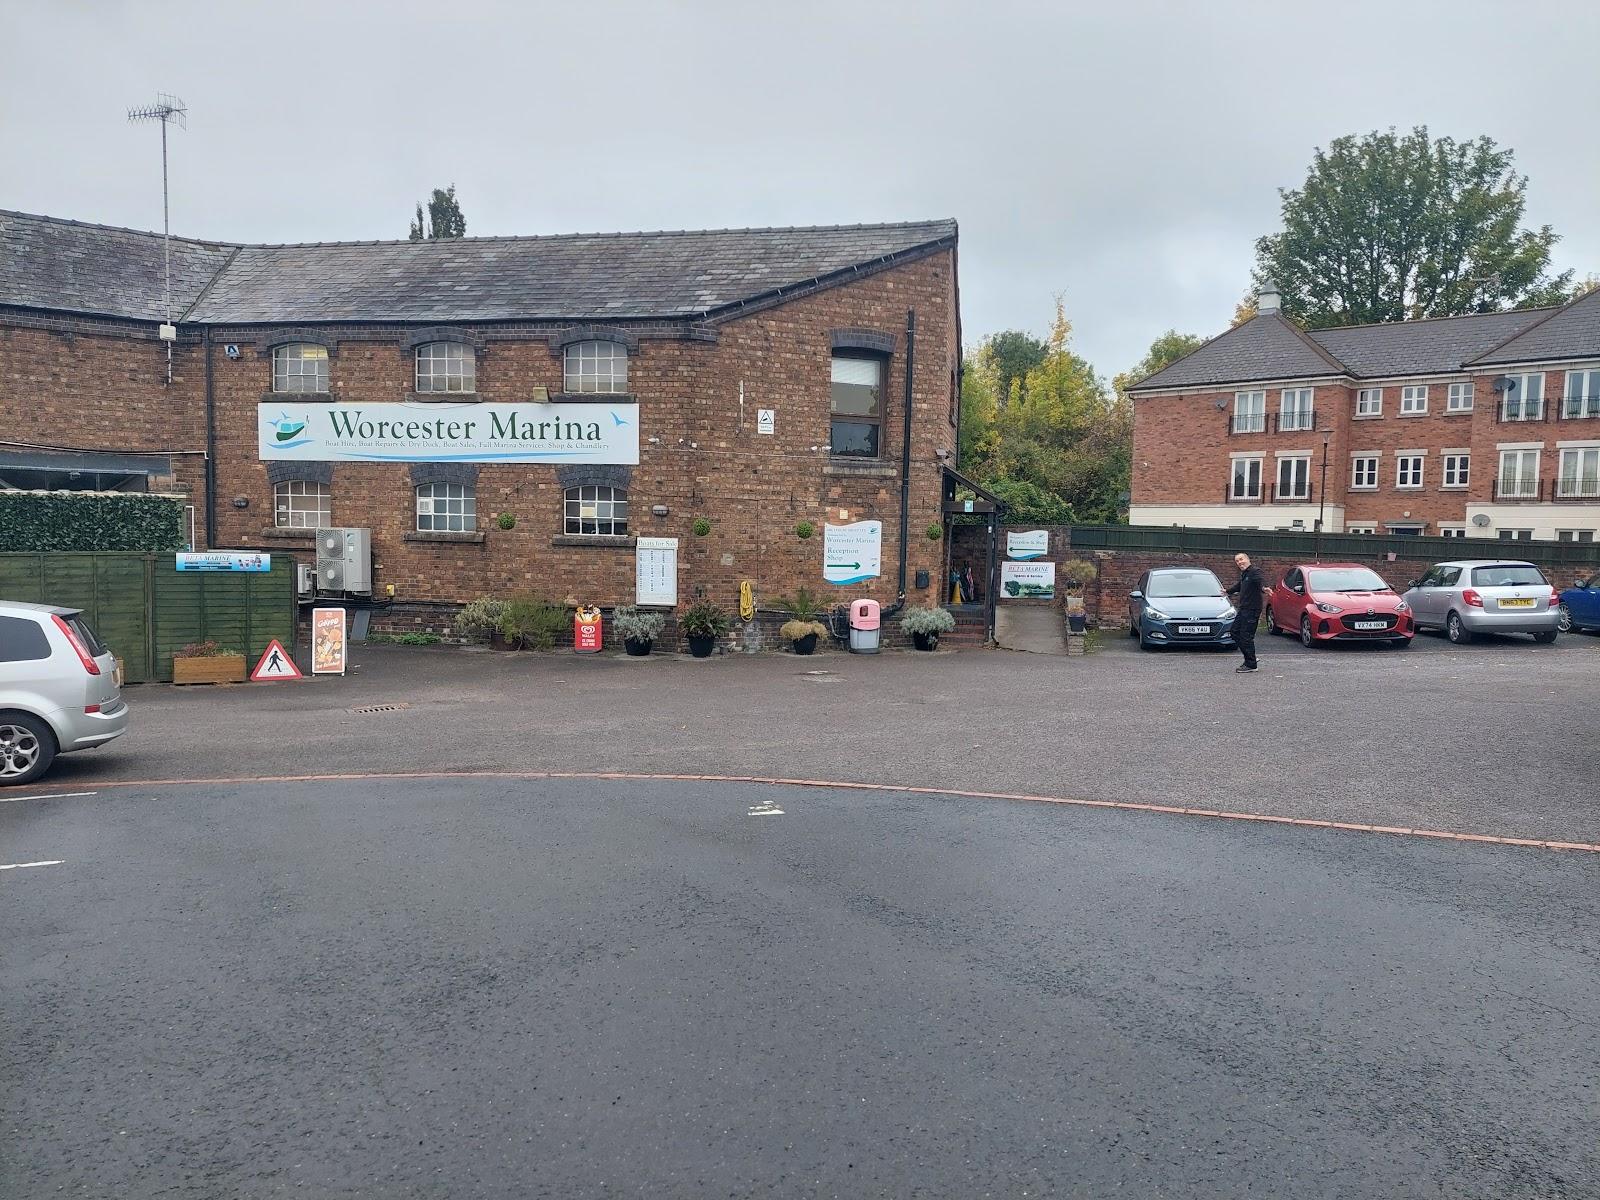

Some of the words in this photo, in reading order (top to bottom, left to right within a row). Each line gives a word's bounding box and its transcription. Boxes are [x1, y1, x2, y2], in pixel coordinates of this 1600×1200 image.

[328, 410, 476, 440] Worcester
[488, 411, 601, 441] Marina
[375, 440, 398, 449] Repairs
[408, 440, 420, 449] Dry
[548, 442, 565, 450] Shop
[575, 442, 609, 450] Chandlery
[827, 546, 859, 555] Reception
